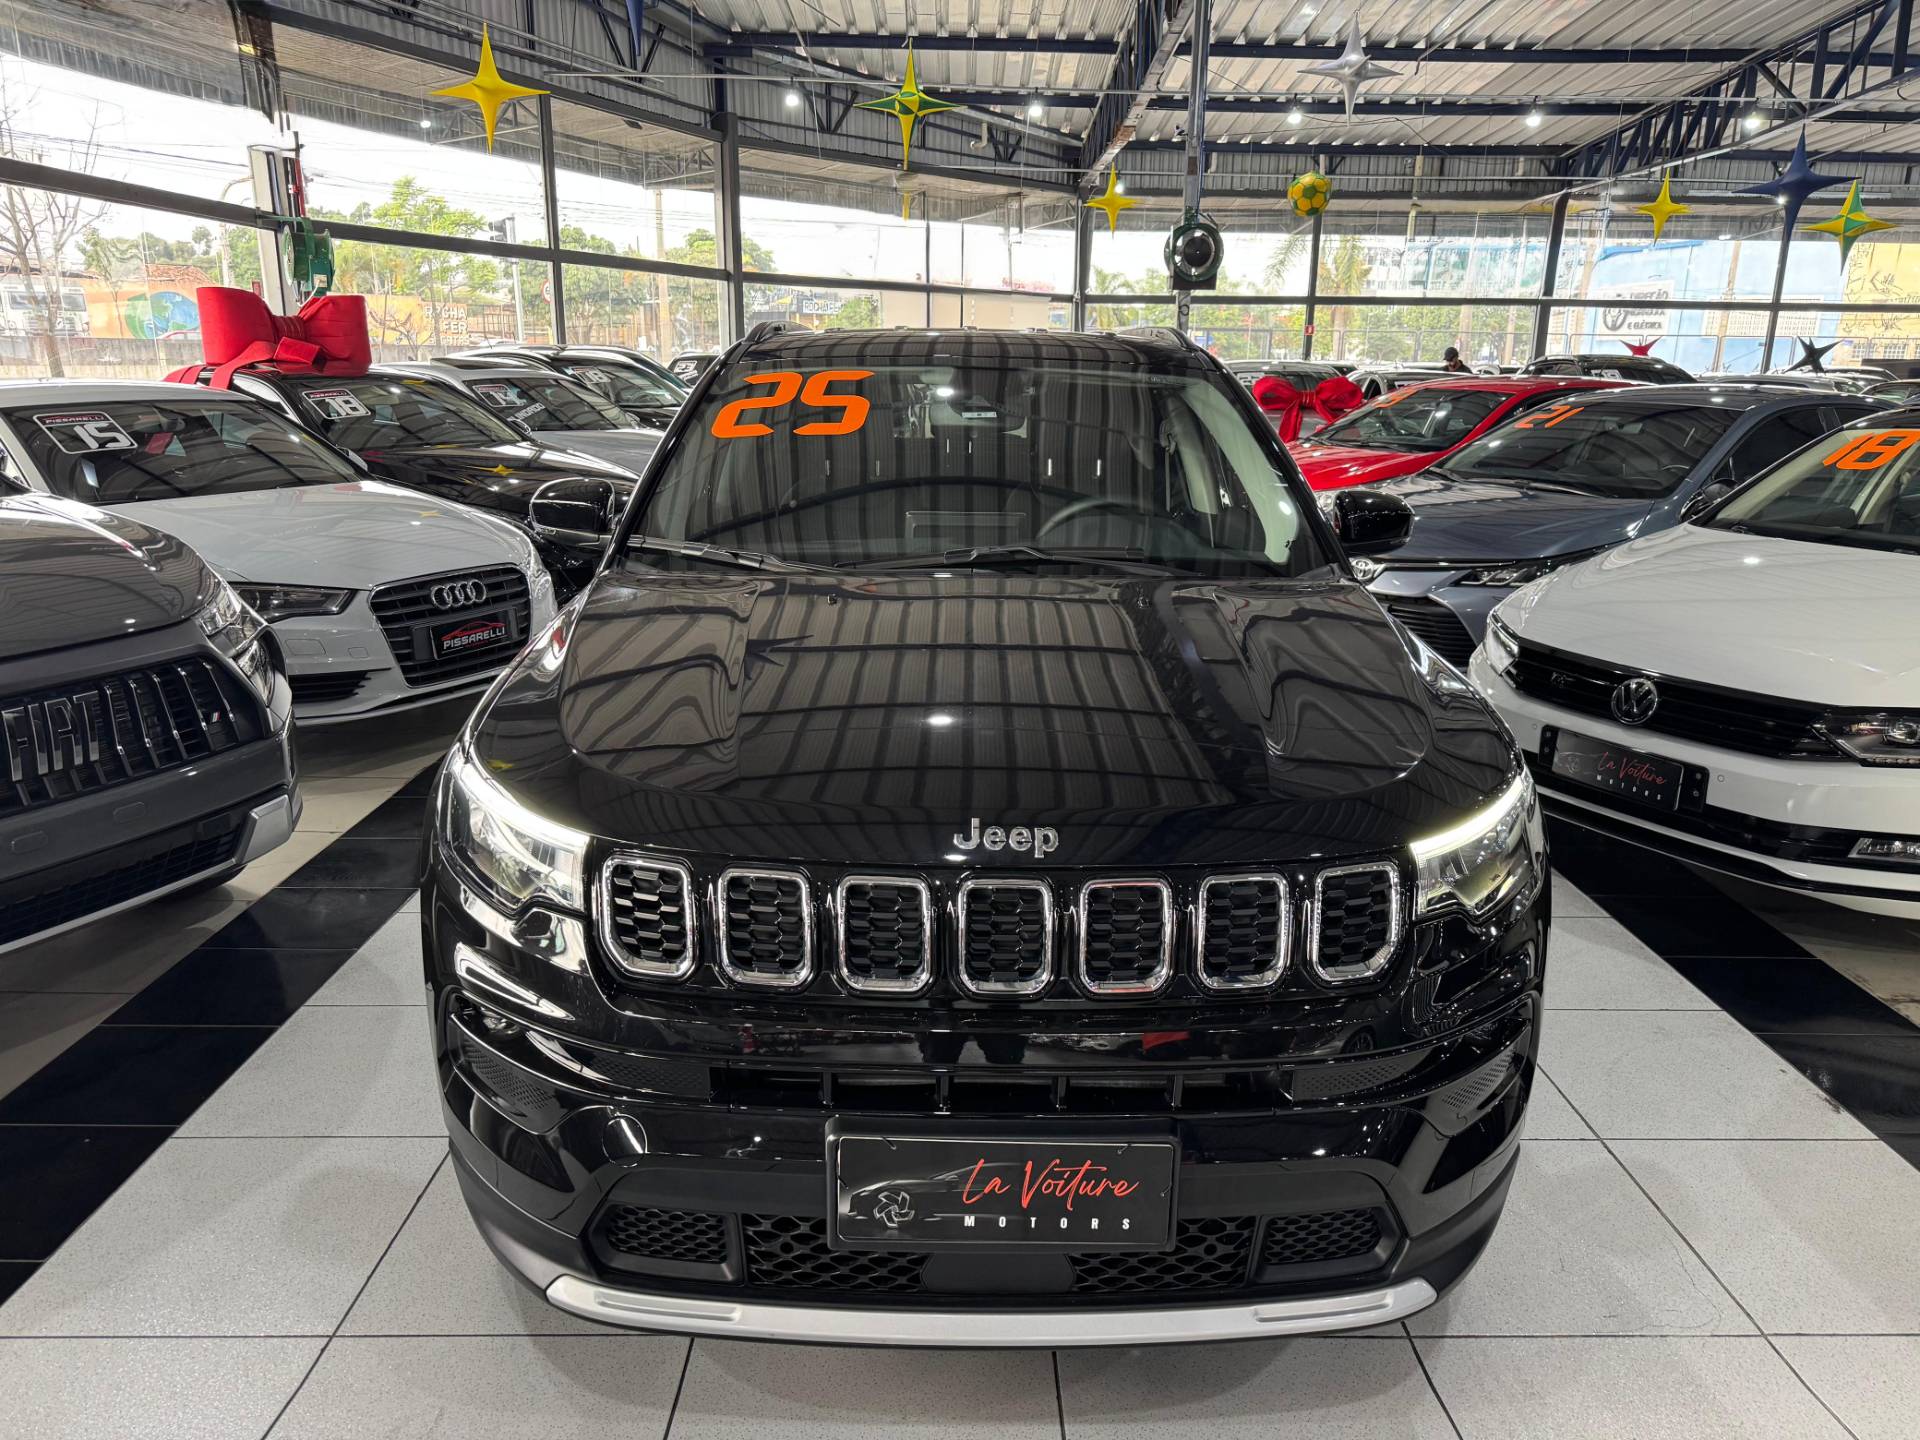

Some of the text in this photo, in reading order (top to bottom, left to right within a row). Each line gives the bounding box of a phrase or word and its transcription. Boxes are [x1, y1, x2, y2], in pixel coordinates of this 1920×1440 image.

[325, 397, 368, 416] 18
[710, 369, 875, 439] 25
[1514, 404, 1585, 429] 21
[73, 422, 131, 450] 15
[1822, 428, 1920, 470] 18
[443, 626, 506, 650] PISSARELLI
[1, 690, 100, 782] FIAT
[1619, 757, 1666, 785] Voiture
[952, 817, 1059, 859] Jeep
[961, 1158, 1140, 1212] La Voiture
[963, 1215, 1131, 1230] MOTORS
